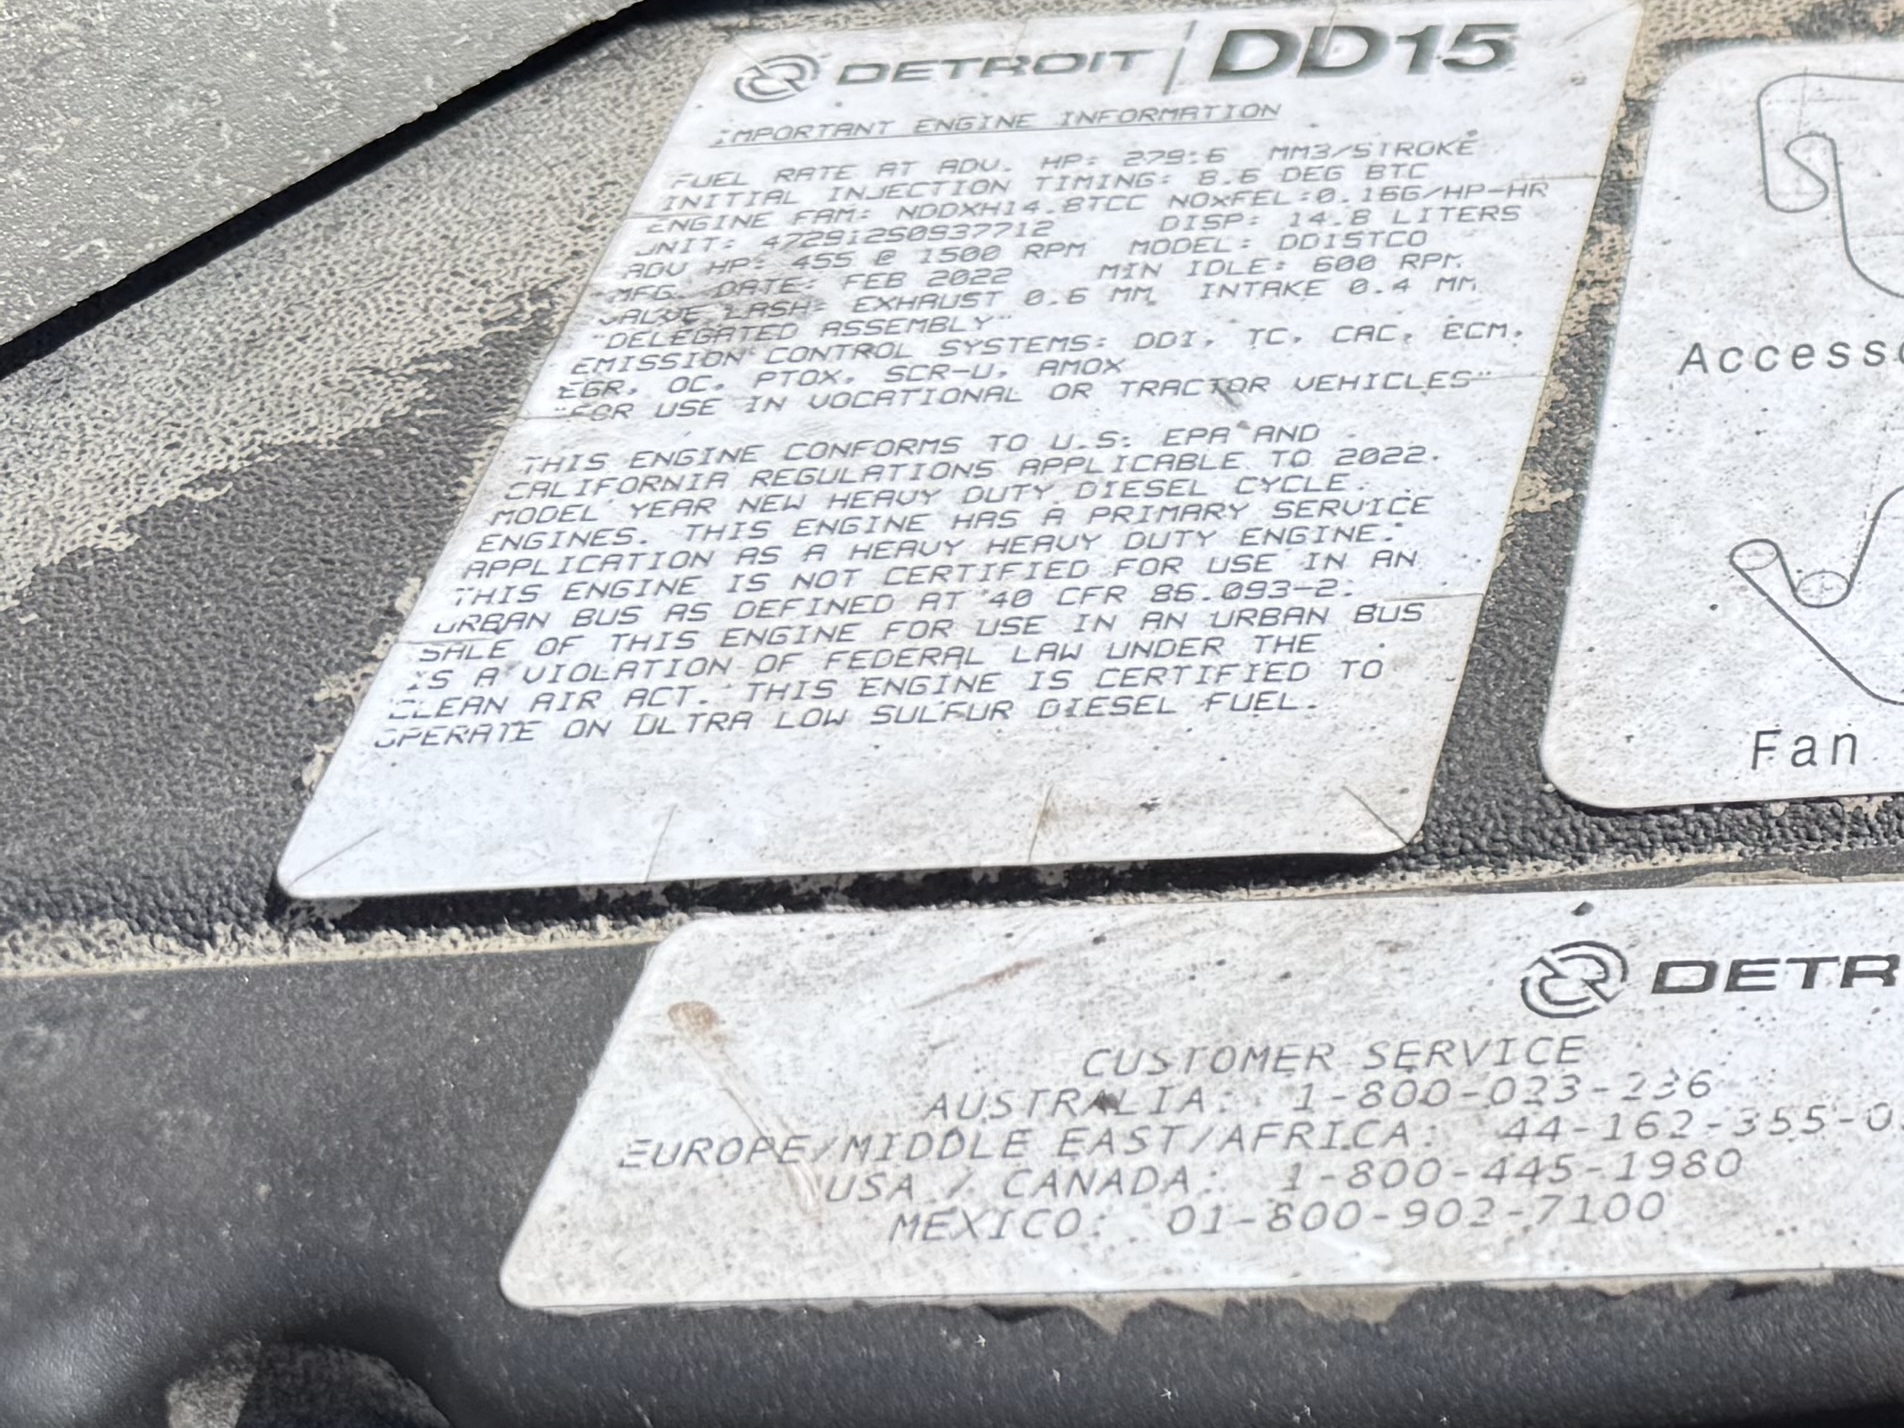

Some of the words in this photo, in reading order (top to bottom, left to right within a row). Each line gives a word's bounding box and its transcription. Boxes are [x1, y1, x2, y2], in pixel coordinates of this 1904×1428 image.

[836, 49, 1154, 86] DETROIT
[1208, 22, 1520, 83] DD15
[714, 121, 892, 143] IMPORTANT
[914, 113, 1035, 132] ENGINE
[1058, 103, 1281, 126] INFORMATION
[661, 188, 798, 211] INITIAL
[827, 178, 1011, 202] INJECTION
[1035, 171, 1170, 191] TIMING:
[1196, 167, 1260, 186] 8.6
[1280, 164, 1344, 183] DEG
[1364, 162, 1428, 180] BTC
[669, 170, 748, 189] FUEL
[773, 163, 857, 182] RATE
[874, 160, 919, 178] AT
[1039, 152, 1098, 169] HP:
[633, 235, 735, 257] UNIT:
[1158, 212, 1259, 232] DISP:
[1288, 208, 1371, 227] 14.8
[1391, 204, 1521, 225] LITERS
[645, 211, 773, 233] ENGINE
[790, 207, 870, 225] FAM:
[620, 261, 689, 279] ADV
[704, 252, 766, 274] HP:
[790, 250, 855, 270] 455
[919, 244, 1001, 264] 1500
[1021, 241, 1087, 259] RPM
[1127, 235, 1251, 255] MODEL:
[841, 270, 907, 290] FEB
[925, 266, 1013, 287] 2022
[1096, 261, 1162, 279] MIN
[1185, 256, 1286, 277] IDLE:
[1312, 253, 1377, 273] 600
[1398, 251, 1462, 270] RPM
[851, 289, 1003, 313] EXHAUST
[1022, 286, 1089, 306] 0.6
[1198, 278, 1327, 300] INTAKE
[1347, 277, 1410, 295] 0.4
[570, 347, 748, 375] EMISSION
[763, 341, 912, 364] CONTROL
[938, 333, 1106, 357] SYSTEMS:
[665, 374, 725, 394] OC,
[1035, 357, 1126, 377] AMOX
[652, 396, 723, 419] USE
[744, 394, 788, 414] IN
[807, 385, 1022, 409] VOCATIONAL
[1047, 381, 1093, 401] OR
[1119, 375, 1270, 397] TRACTOR
[517, 451, 610, 475] THIS
[628, 443, 764, 469] ENGINE
[782, 435, 963, 461] CONFORMS
[987, 432, 1029, 452] TO
[1161, 425, 1230, 446] EPA
[1251, 422, 1320, 443] AND
[504, 470, 728, 500] CALIFORNIA
[748, 459, 996, 487] REGULATIONS
[1017, 450, 1244, 475] APPLICABLE
[1270, 447, 1312, 468] TO
[475, 526, 647, 553] ENGINES.
[685, 519, 772, 542] THIS
[791, 512, 930, 537] ENGINE
[950, 508, 1021, 530] HAS
[1040, 506, 1065, 526] A
[1086, 501, 1249, 525] PRIMARY
[1271, 494, 1434, 519] SERVICE
[488, 500, 599, 526] MODEL
[629, 496, 717, 519] YEAR
[735, 493, 806, 513] NEW
[826, 488, 942, 509] HEAVY
[960, 482, 1055, 505] DUTY
[1073, 477, 1207, 500] DIESEL
[454, 582, 542, 607] THIS
[561, 574, 702, 601] ENGINE
[725, 571, 771, 594] IS
[789, 567, 862, 590] NOT
[881, 558, 1089, 586] CERTIFIED
[1112, 555, 1184, 577] FOR
[1205, 552, 1277, 574] USE
[1298, 551, 1347, 571] IN
[1369, 548, 1418, 569] AN
[461, 549, 714, 579] APPLICATION
[733, 544, 782, 565] AS
[801, 542, 828, 562] A
[847, 538, 965, 560] HEAVY
[984, 532, 1102, 554] HEAVY
[1122, 528, 1217, 550] DUTY
[417, 637, 514, 663] SALE
[533, 633, 585, 656] OF
[610, 629, 699, 652] THIS
[718, 621, 861, 648] ENGINE
[880, 617, 954, 640] FOR
[974, 613, 1047, 637] USE
[1072, 612, 1117, 633] IN
[1139, 610, 1188, 630] AN
[1210, 605, 1329, 629] URBAN
[1351, 598, 1427, 624] BUS
[433, 610, 551, 634] URBAN
[570, 604, 643, 627] BUS
[662, 601, 712, 623] AS
[732, 593, 894, 620] DEFINED
[916, 589, 966, 611] AT
[986, 587, 1033, 608] 40
[1055, 584, 1127, 606] CFR
[472, 666, 500, 687] A
[521, 656, 732, 684] VIOLATION
[751, 651, 803, 676] OF
[823, 645, 983, 671] FEDERAL
[1009, 641, 1083, 664] LAW
[1104, 635, 1225, 660] UNDER
[1253, 632, 1322, 654] THE
[387, 695, 509, 720] CLEAN
[528, 689, 602, 713] AIR
[622, 684, 708, 708] ACT.
[746, 678, 837, 702] THIS
[857, 671, 1001, 698] ENGINE
[1024, 668, 1073, 692] IS
[1094, 660, 1310, 689] CERTIFIED
[1339, 658, 1383, 680] TO
[373, 719, 542, 749] OPERATE
[559, 718, 612, 740] ON
[631, 709, 753, 736] ULTRA
[773, 706, 848, 730] LOW
[868, 699, 1014, 725] SULFUR
[1035, 693, 1176, 719] DIESEL
[1204, 689, 1328, 712] FUEL.
[1749, 727, 1860, 773] Fan
[1081, 1041, 1334, 1078] CUSTOMER
[1361, 1034, 1587, 1073] SERVICE
[617, 1127, 1032, 1169] EUROPE/MIDDLE
[1054, 1118, 1436, 1159] EAST/AFRICA:
[823, 1171, 913, 1203] USA
